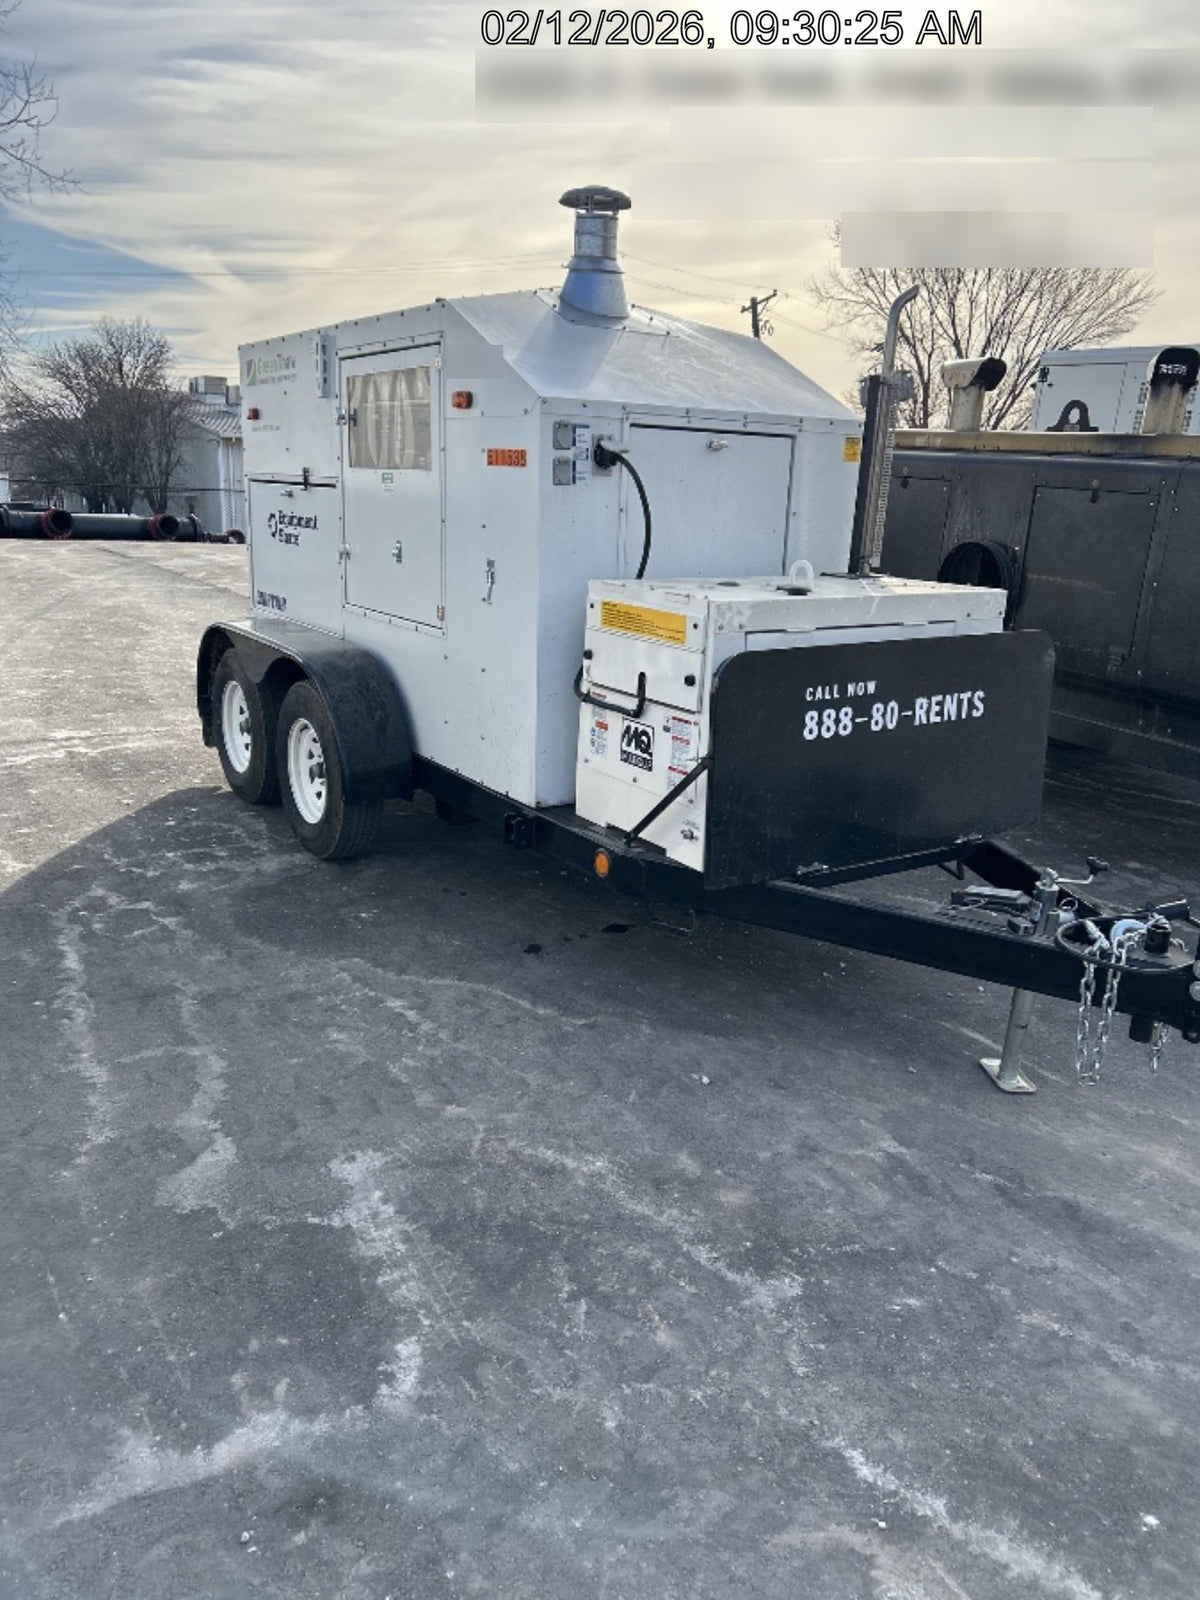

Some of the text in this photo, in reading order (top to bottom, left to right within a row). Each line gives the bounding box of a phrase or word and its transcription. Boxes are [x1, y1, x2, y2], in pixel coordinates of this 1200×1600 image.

[805, 680, 877, 701] CALL NOW
[803, 689, 986, 741] 888-80-RENTS
[621, 724, 653, 758] MQ
